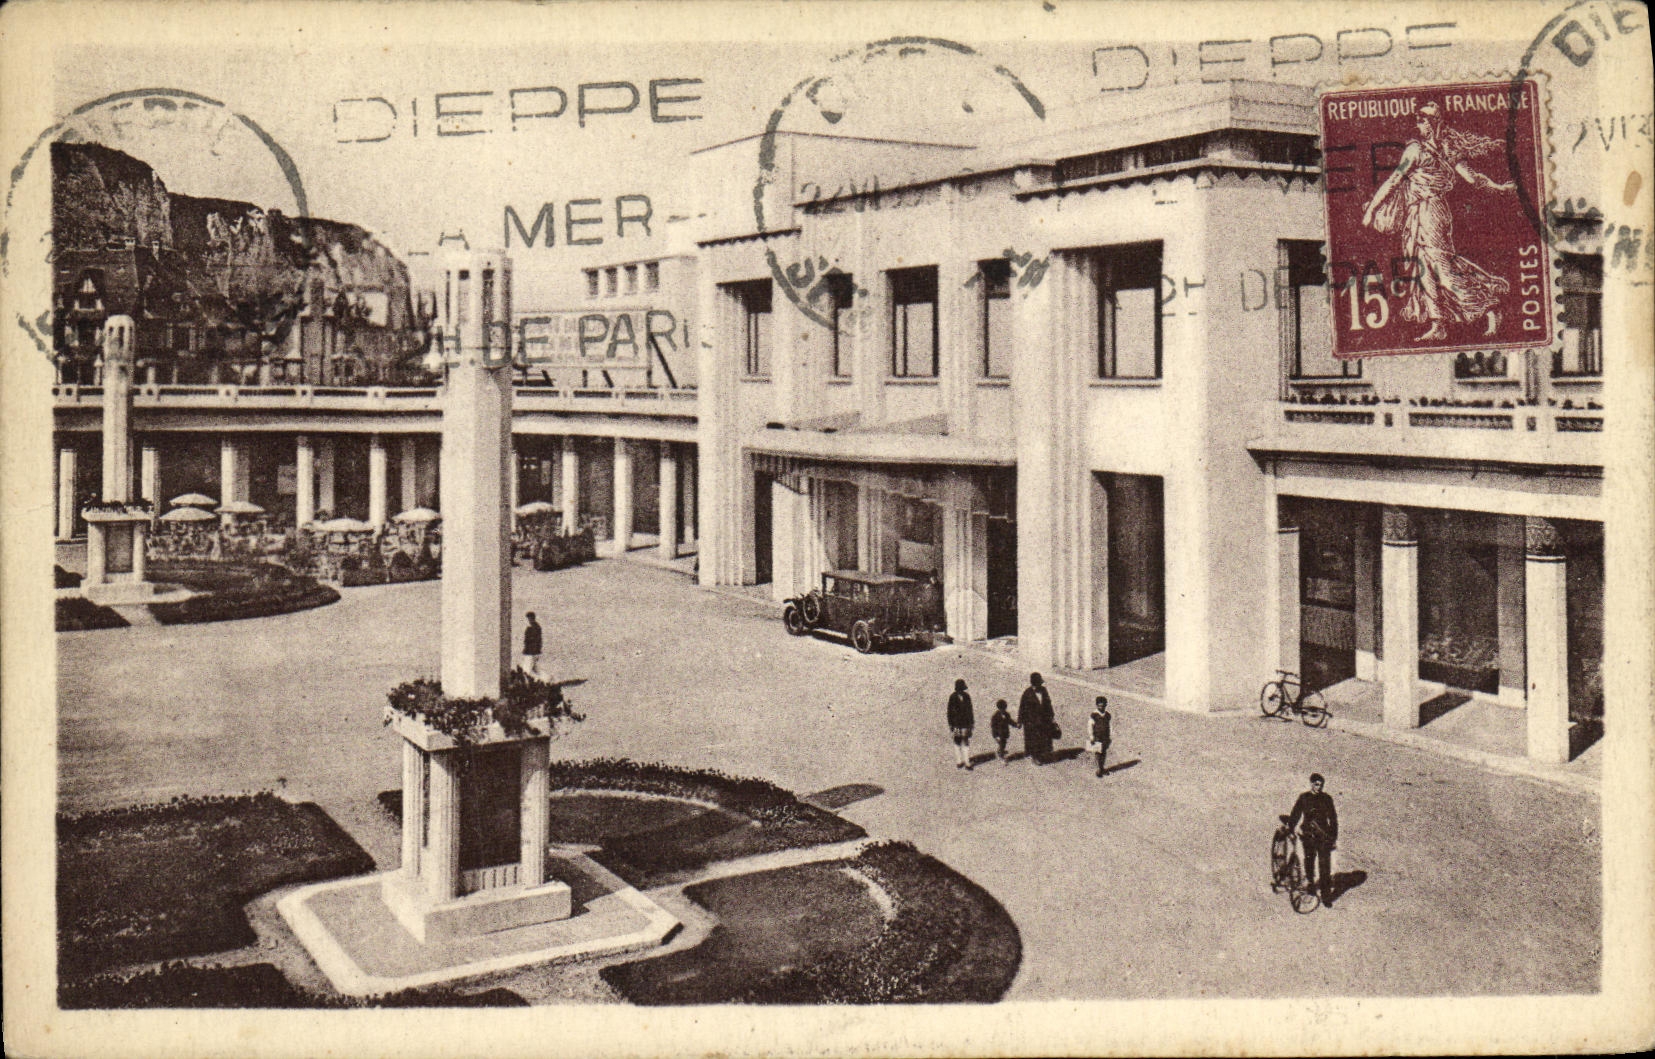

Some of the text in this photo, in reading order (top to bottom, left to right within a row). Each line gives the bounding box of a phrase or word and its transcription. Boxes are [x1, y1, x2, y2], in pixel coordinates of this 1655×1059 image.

[1092, 22, 1457, 92] DIEPPE
[332, 78, 704, 144] DIEPPE
[503, 193, 653, 249] MER
[1517, 243, 1542, 332] POSTES
[480, 315, 552, 368] DE
[578, 309, 712, 358] PARI
